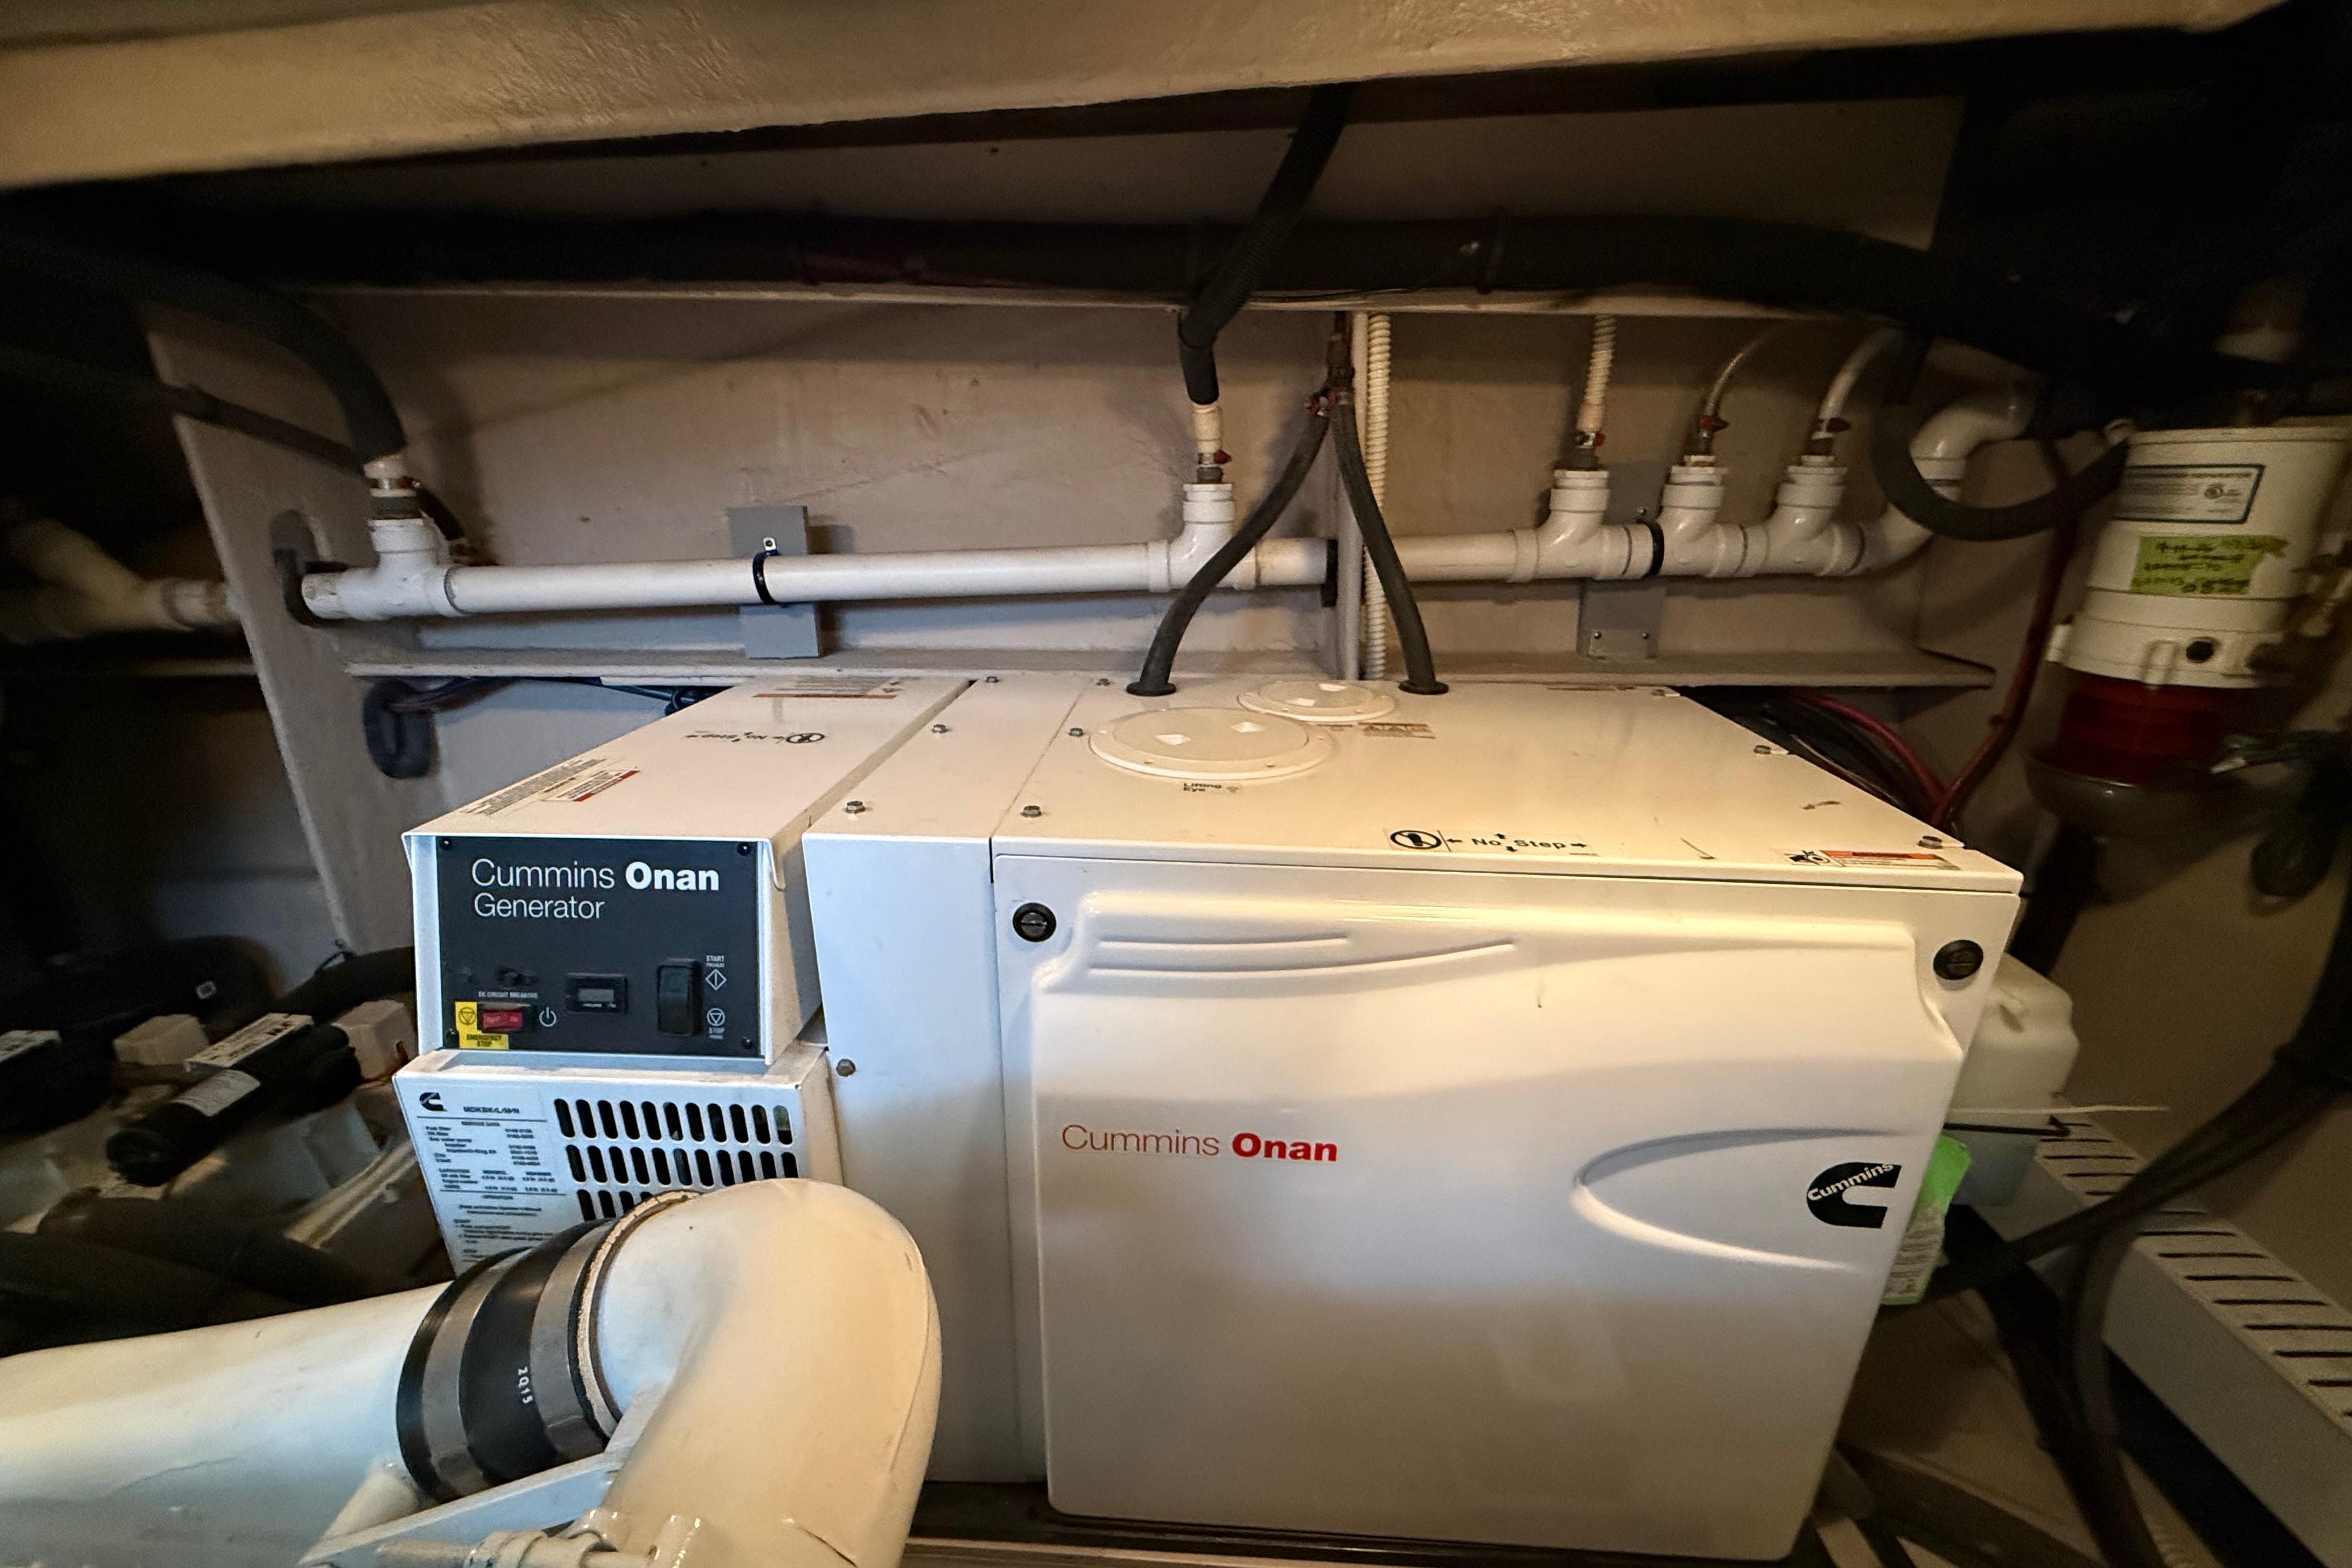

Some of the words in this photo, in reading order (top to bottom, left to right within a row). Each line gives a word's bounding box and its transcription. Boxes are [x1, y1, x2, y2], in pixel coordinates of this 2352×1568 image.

[1471, 838, 1502, 846] No
[1513, 839, 1566, 849] Step
[471, 858, 615, 889] Cummins
[625, 861, 719, 891] Onan
[474, 892, 606, 919] Generator
[1062, 1124, 1220, 1156] Cummins
[1231, 1132, 1338, 1161] Onan
[1807, 1163, 1894, 1201] Cummins
